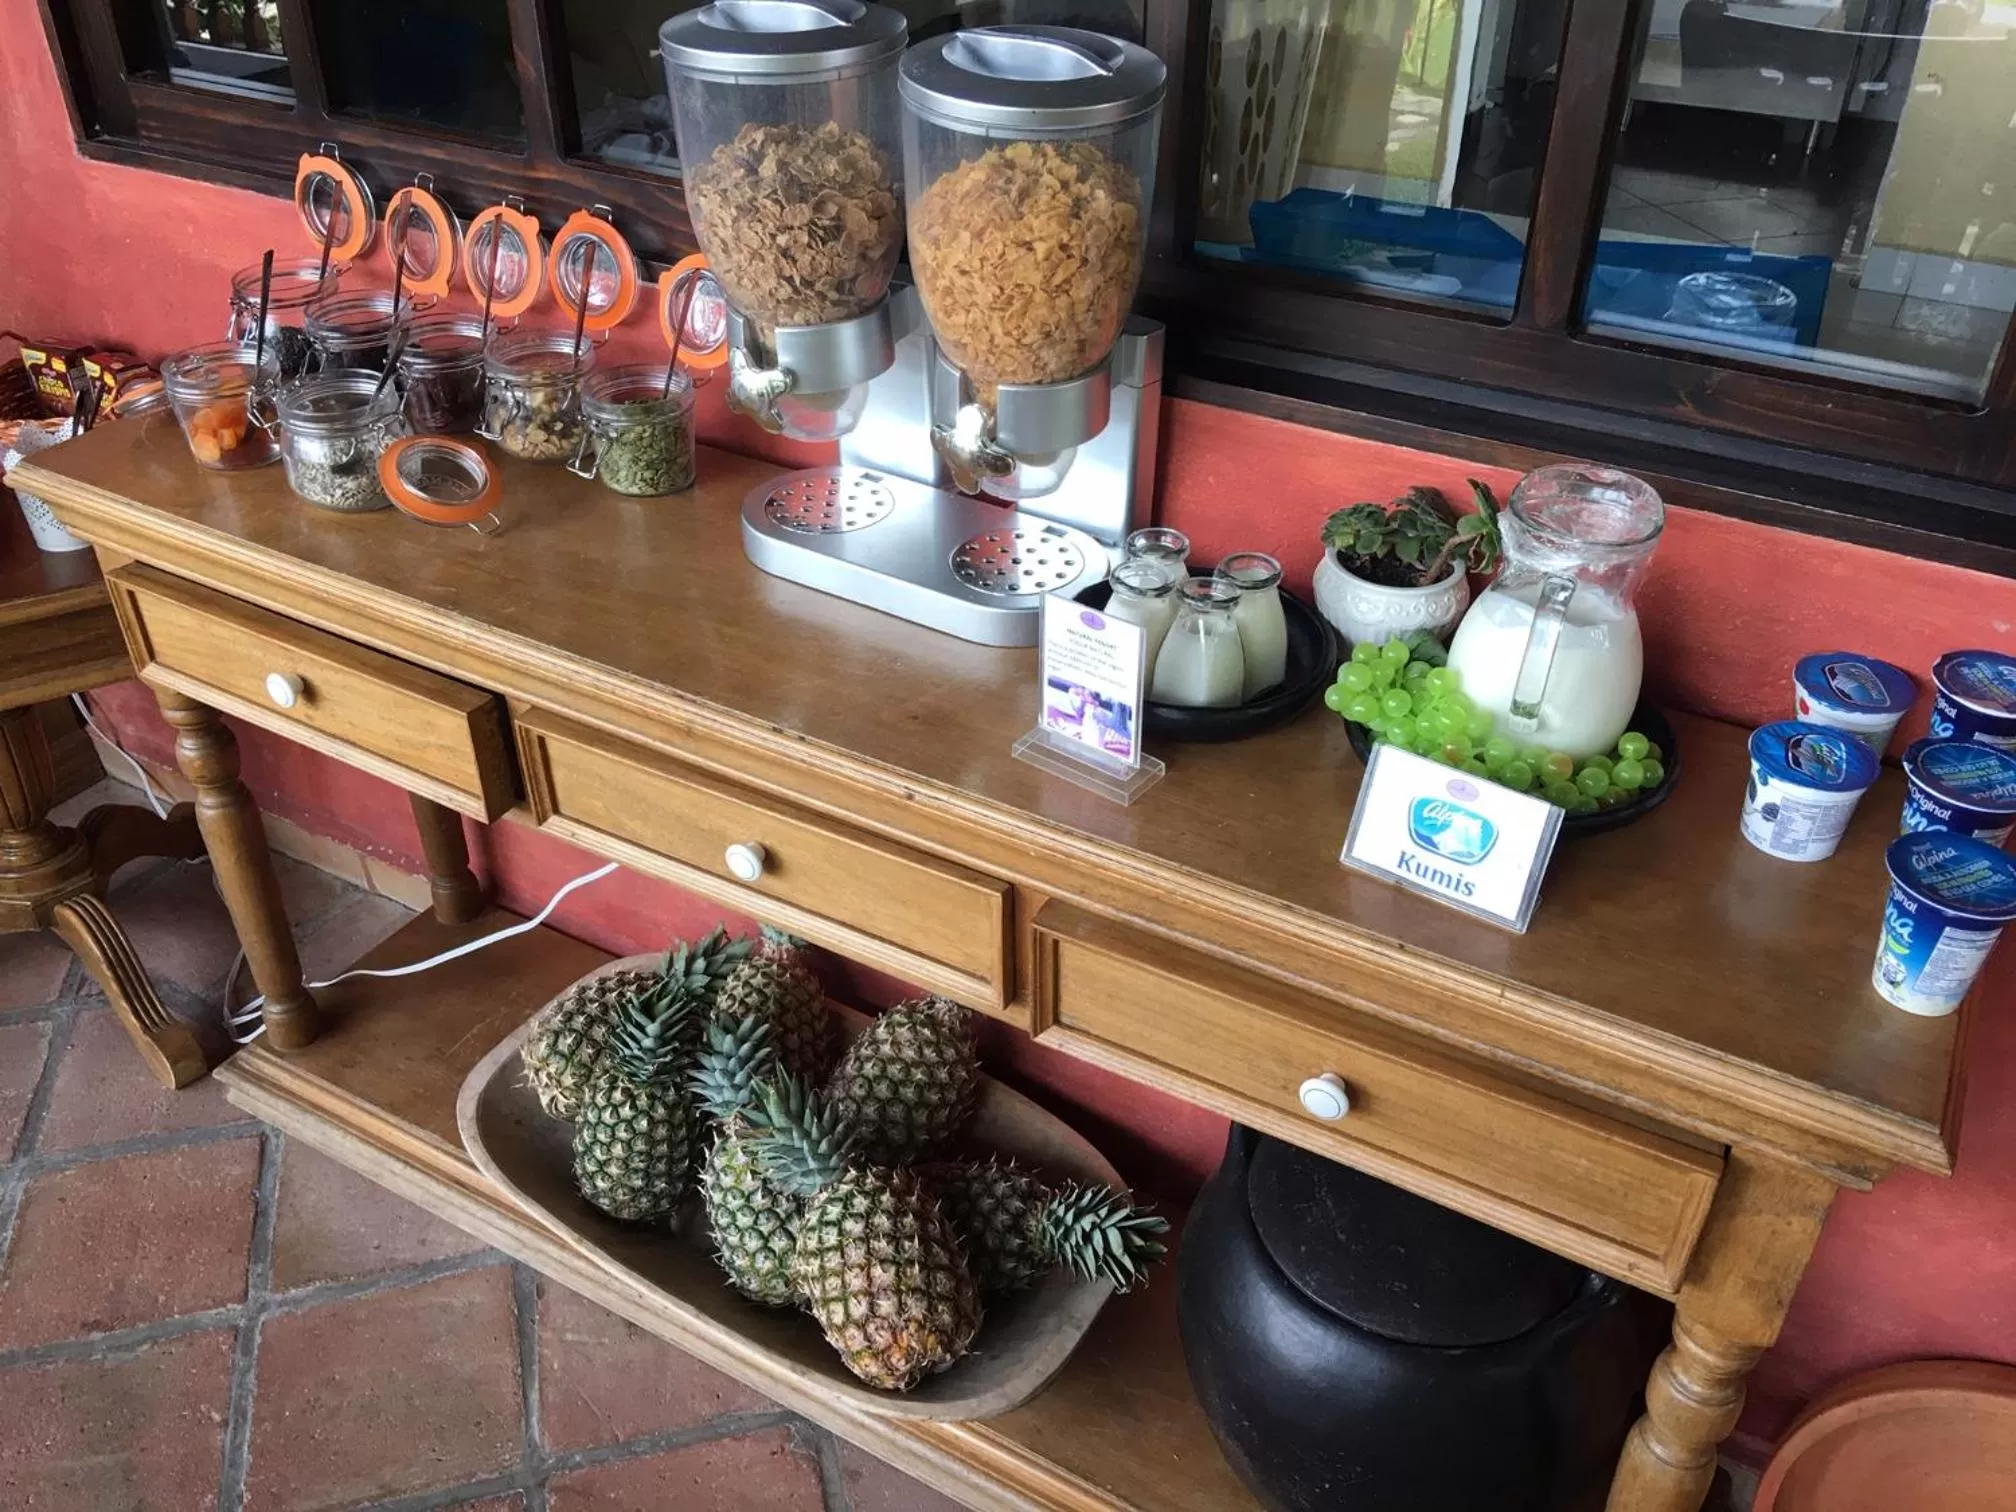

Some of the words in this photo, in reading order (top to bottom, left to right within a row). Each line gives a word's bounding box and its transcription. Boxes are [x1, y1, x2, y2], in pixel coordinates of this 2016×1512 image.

[1937, 696, 1958, 719] ginal
[1911, 786, 1952, 821] Original
[1911, 846, 1959, 871] Alpina
[1396, 850, 1476, 897] Kumis
[1892, 885, 1918, 914] ginal
